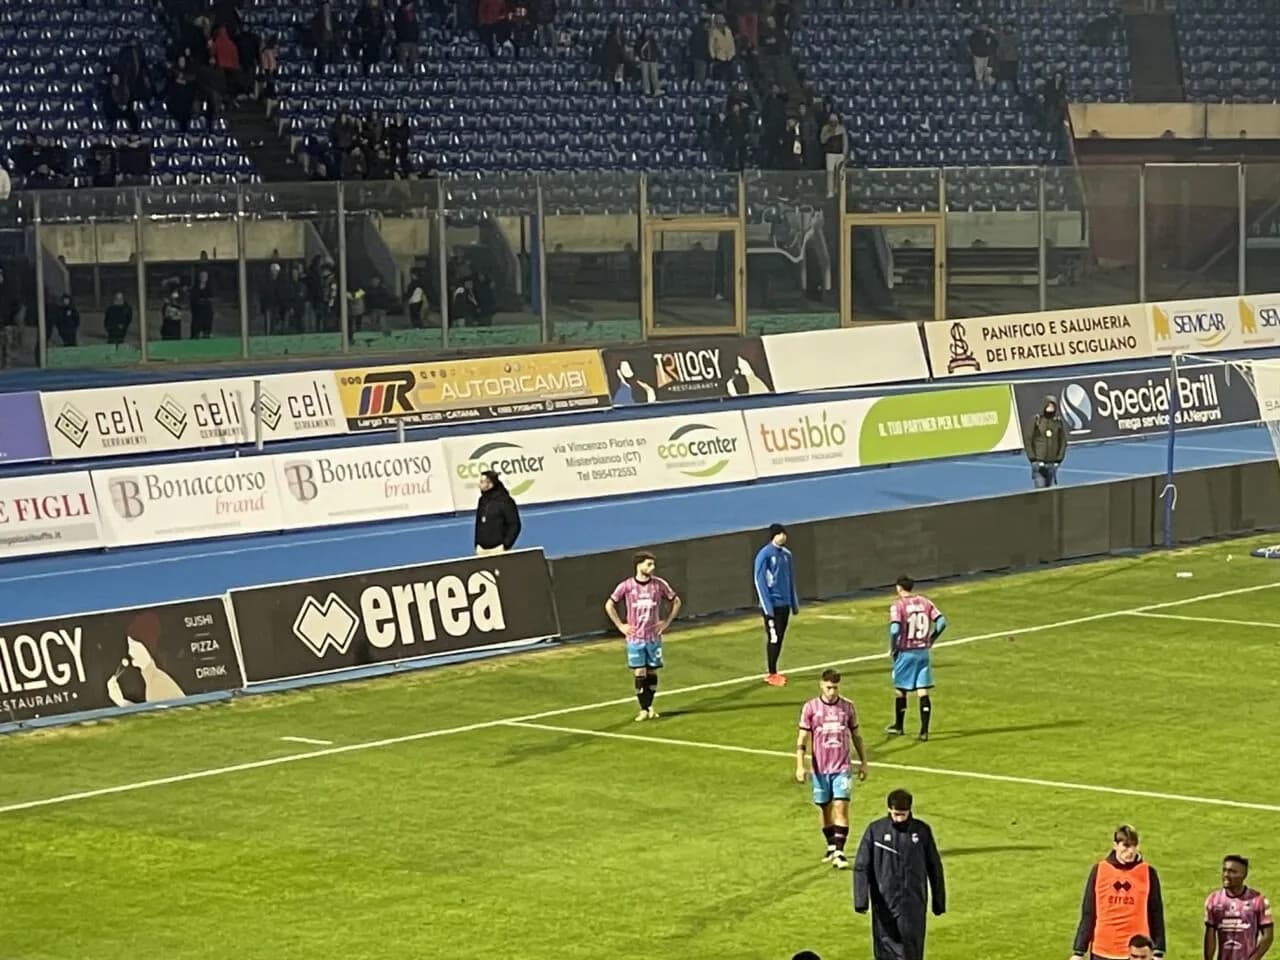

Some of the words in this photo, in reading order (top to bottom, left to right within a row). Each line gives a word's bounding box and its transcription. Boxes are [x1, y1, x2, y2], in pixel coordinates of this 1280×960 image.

[982, 323, 1045, 340] PANIFICIO
[1050, 322, 1057, 334] E
[1060, 315, 1131, 333] SALUMERIA
[987, 348, 1007, 363] DEI
[1011, 341, 1065, 360] FRATELLI
[1069, 335, 1137, 354] SCIGLIANO
[653, 348, 722, 382] TRILOGY
[441, 369, 587, 400] AUTORICAMBI
[1094, 378, 1171, 420] Special
[1176, 373, 1218, 409] Brill
[194, 389, 240, 427] celi
[287, 380, 332, 419] celi
[95, 396, 144, 435] celi
[657, 435, 737, 459] ecocenter
[318, 455, 432, 484] Bonaccorso
[457, 454, 544, 479] ecocenter
[145, 471, 265, 500] Bonaccorso
[384, 477, 432, 499] brand
[14, 493, 91, 522] FIGLI
[215, 492, 265, 515] brand
[184, 614, 213, 628] SUSHI
[907, 612, 929, 639] 19
[191, 640, 219, 653] PIZZA
[195, 664, 228, 679] DRINK
